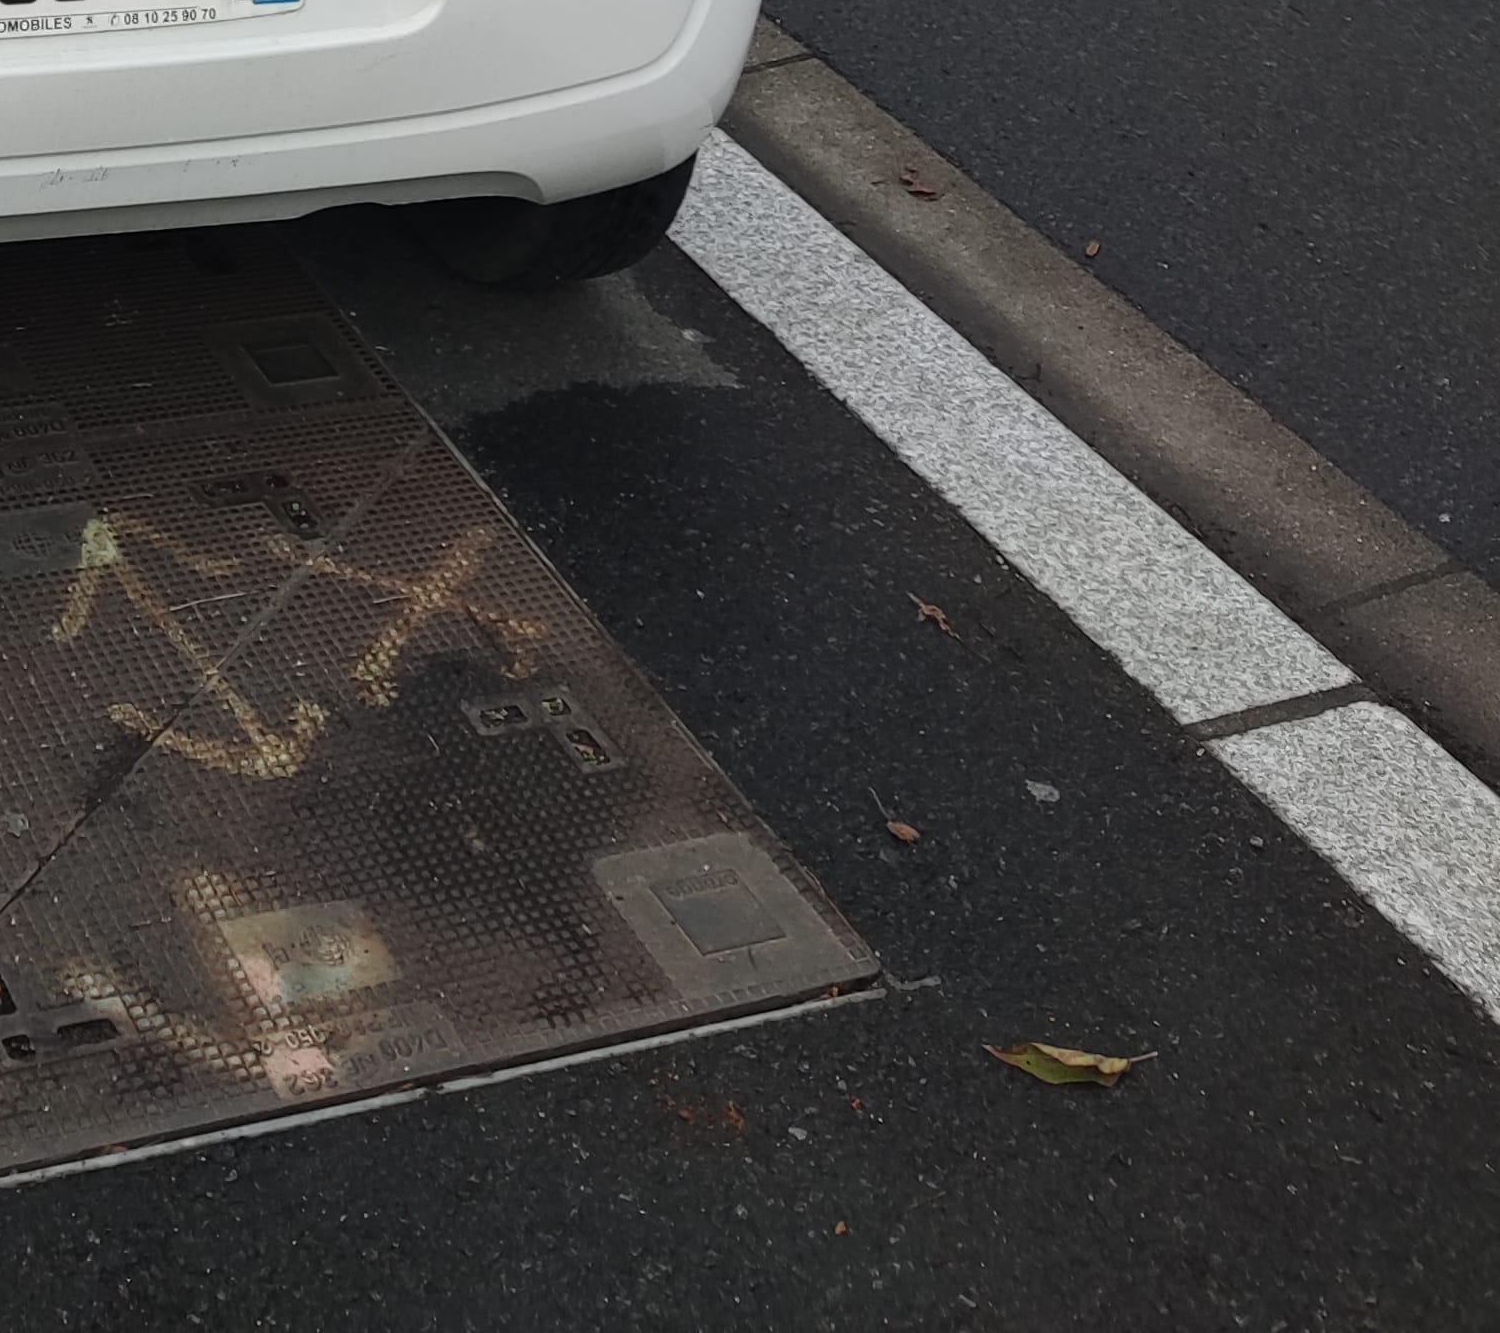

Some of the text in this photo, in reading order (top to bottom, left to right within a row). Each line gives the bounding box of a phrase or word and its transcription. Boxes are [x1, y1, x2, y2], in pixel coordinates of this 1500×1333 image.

[124, 12, 139, 26] 08
[145, 11, 158, 24] 10
[163, 10, 178, 23] 25
[182, 8, 197, 21] 90
[202, 7, 217, 20] 70
[665, 874, 738, 900] orange
[288, 1068, 338, 1097] 362
